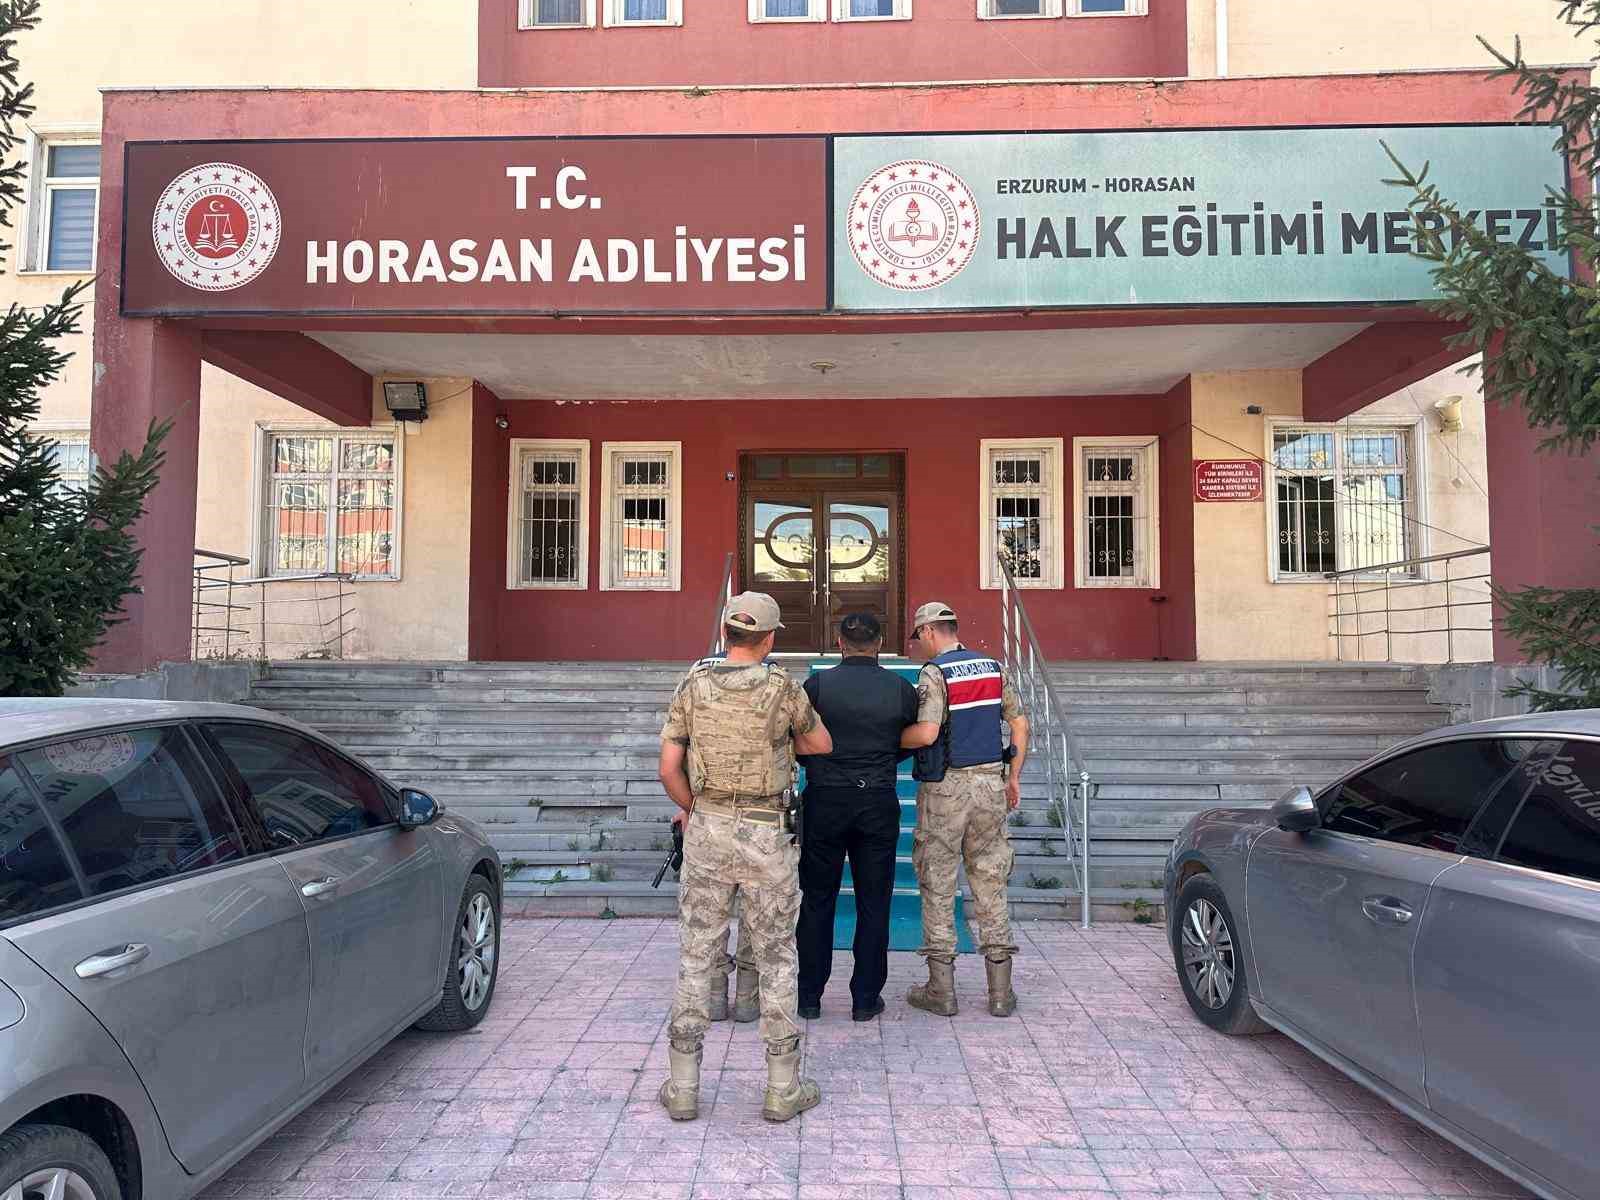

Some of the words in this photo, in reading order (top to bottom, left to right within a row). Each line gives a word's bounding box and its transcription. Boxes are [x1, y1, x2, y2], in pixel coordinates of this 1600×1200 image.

[507, 166, 602, 210] T.C.
[997, 178, 1087, 195] ERZURUM
[1105, 176, 1196, 193] HORASAN
[306, 238, 553, 284] HORASAN
[567, 225, 806, 284] ADLİYESİ
[997, 215, 1128, 260] HALK
[1141, 201, 1325, 258] EĞİTİMİ
